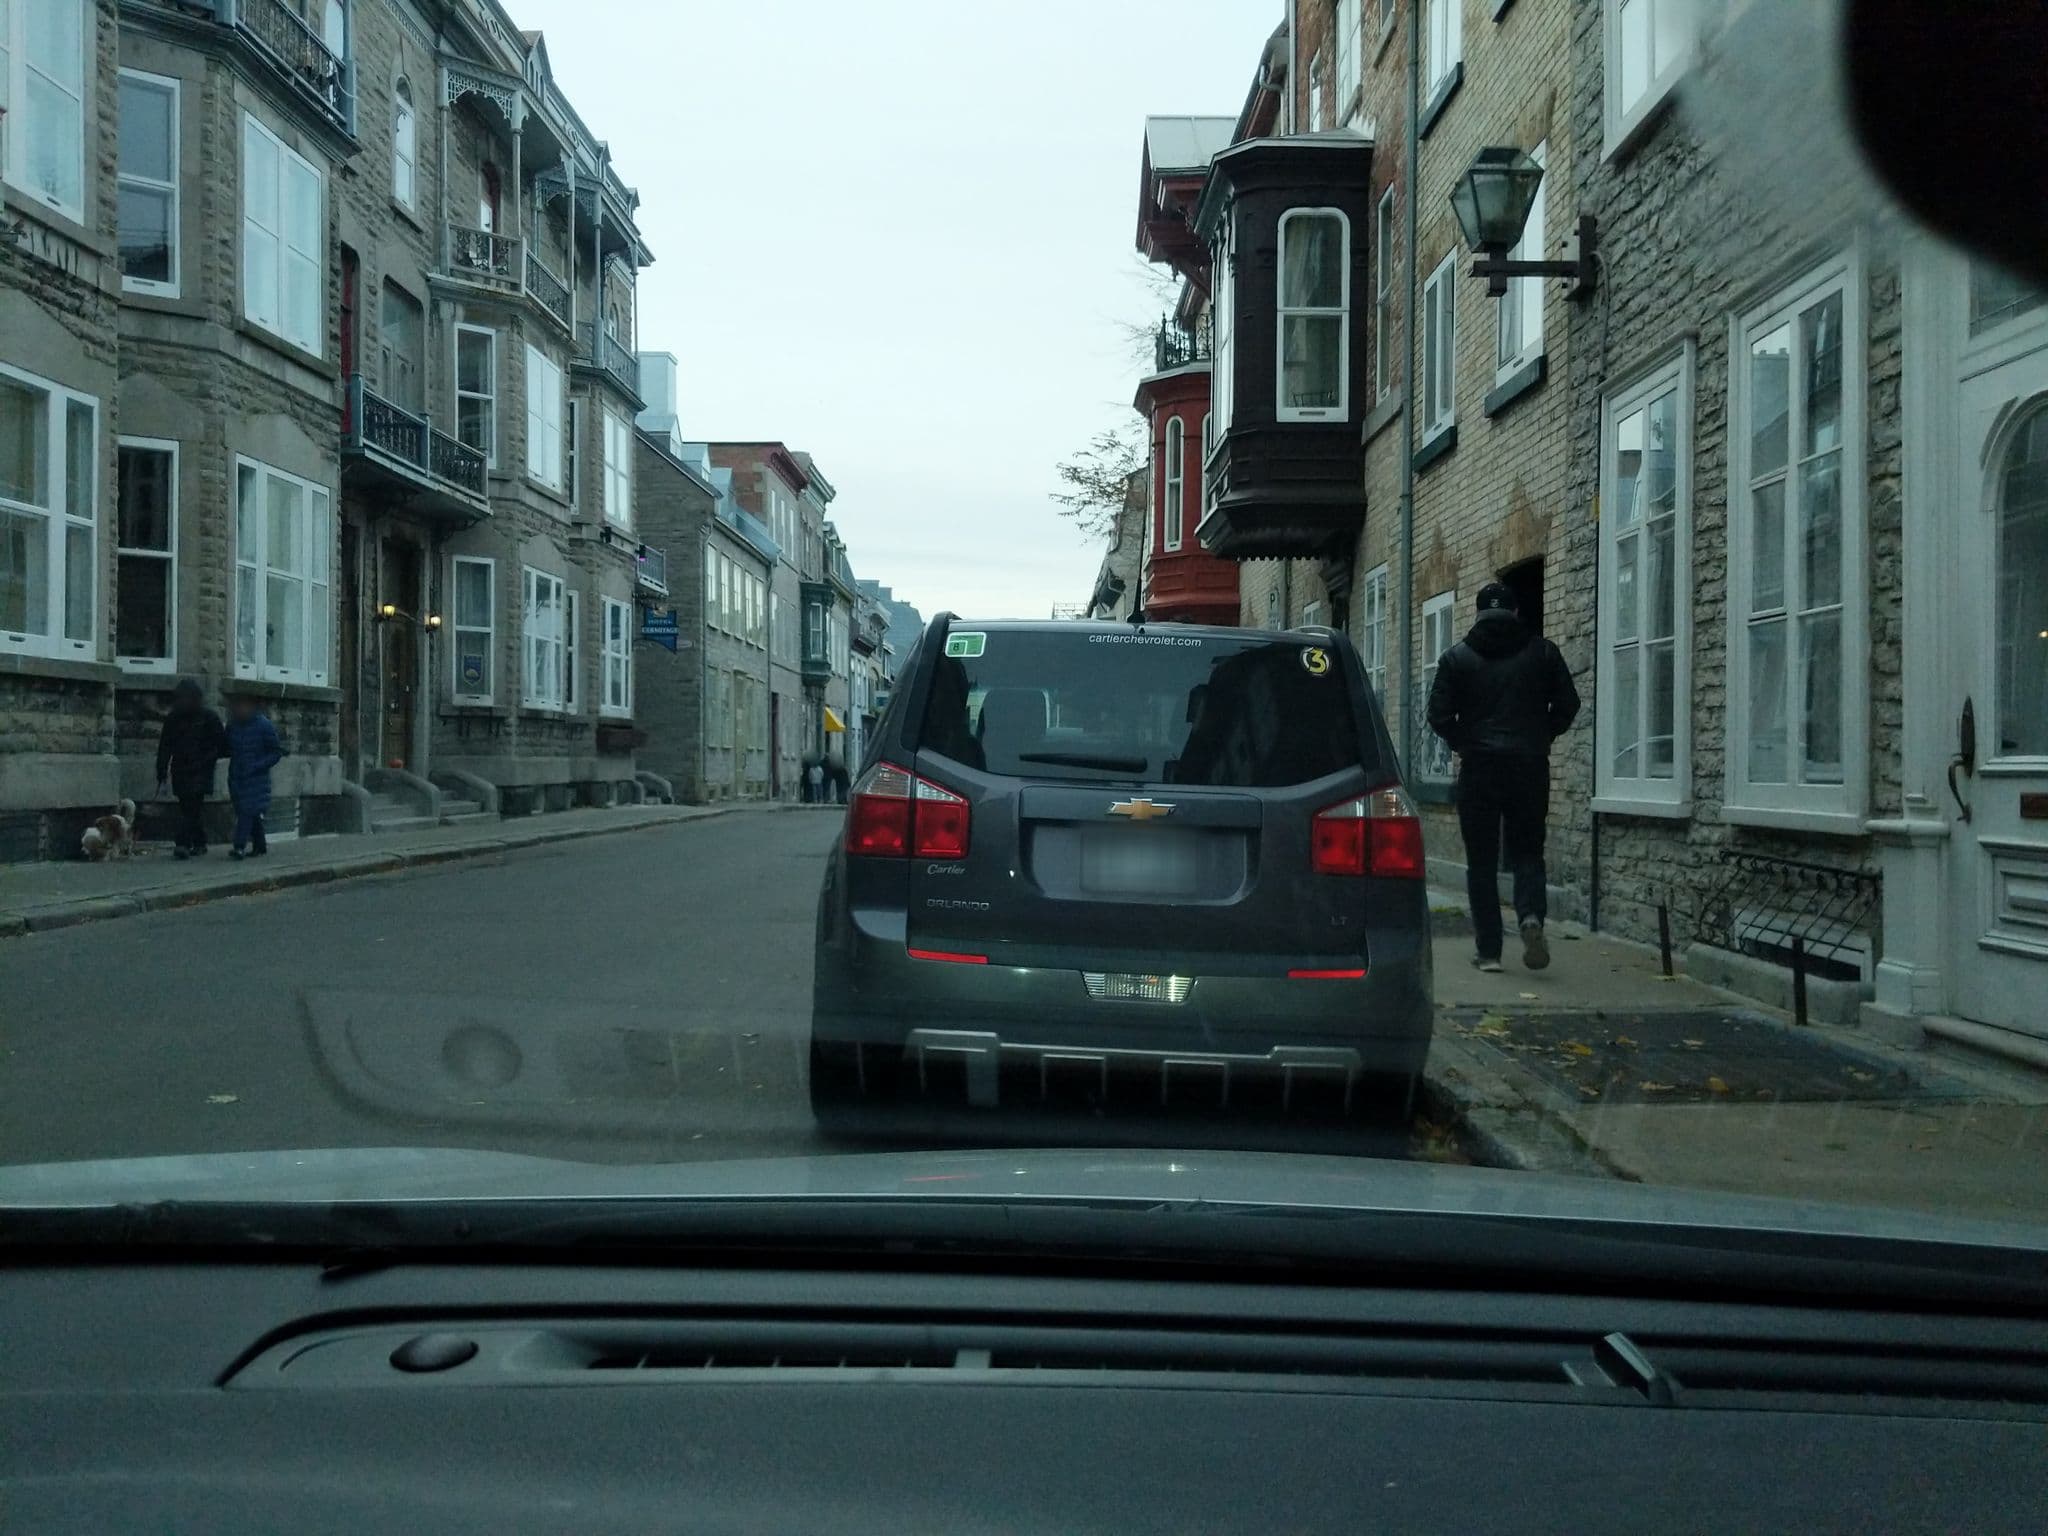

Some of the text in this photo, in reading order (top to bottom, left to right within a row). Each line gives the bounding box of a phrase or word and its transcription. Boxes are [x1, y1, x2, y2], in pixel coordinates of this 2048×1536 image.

[1088, 633, 1202, 648] cartierchevrolet.com
[927, 863, 966, 875] Cartier
[927, 898, 990, 911] ORLANDO
